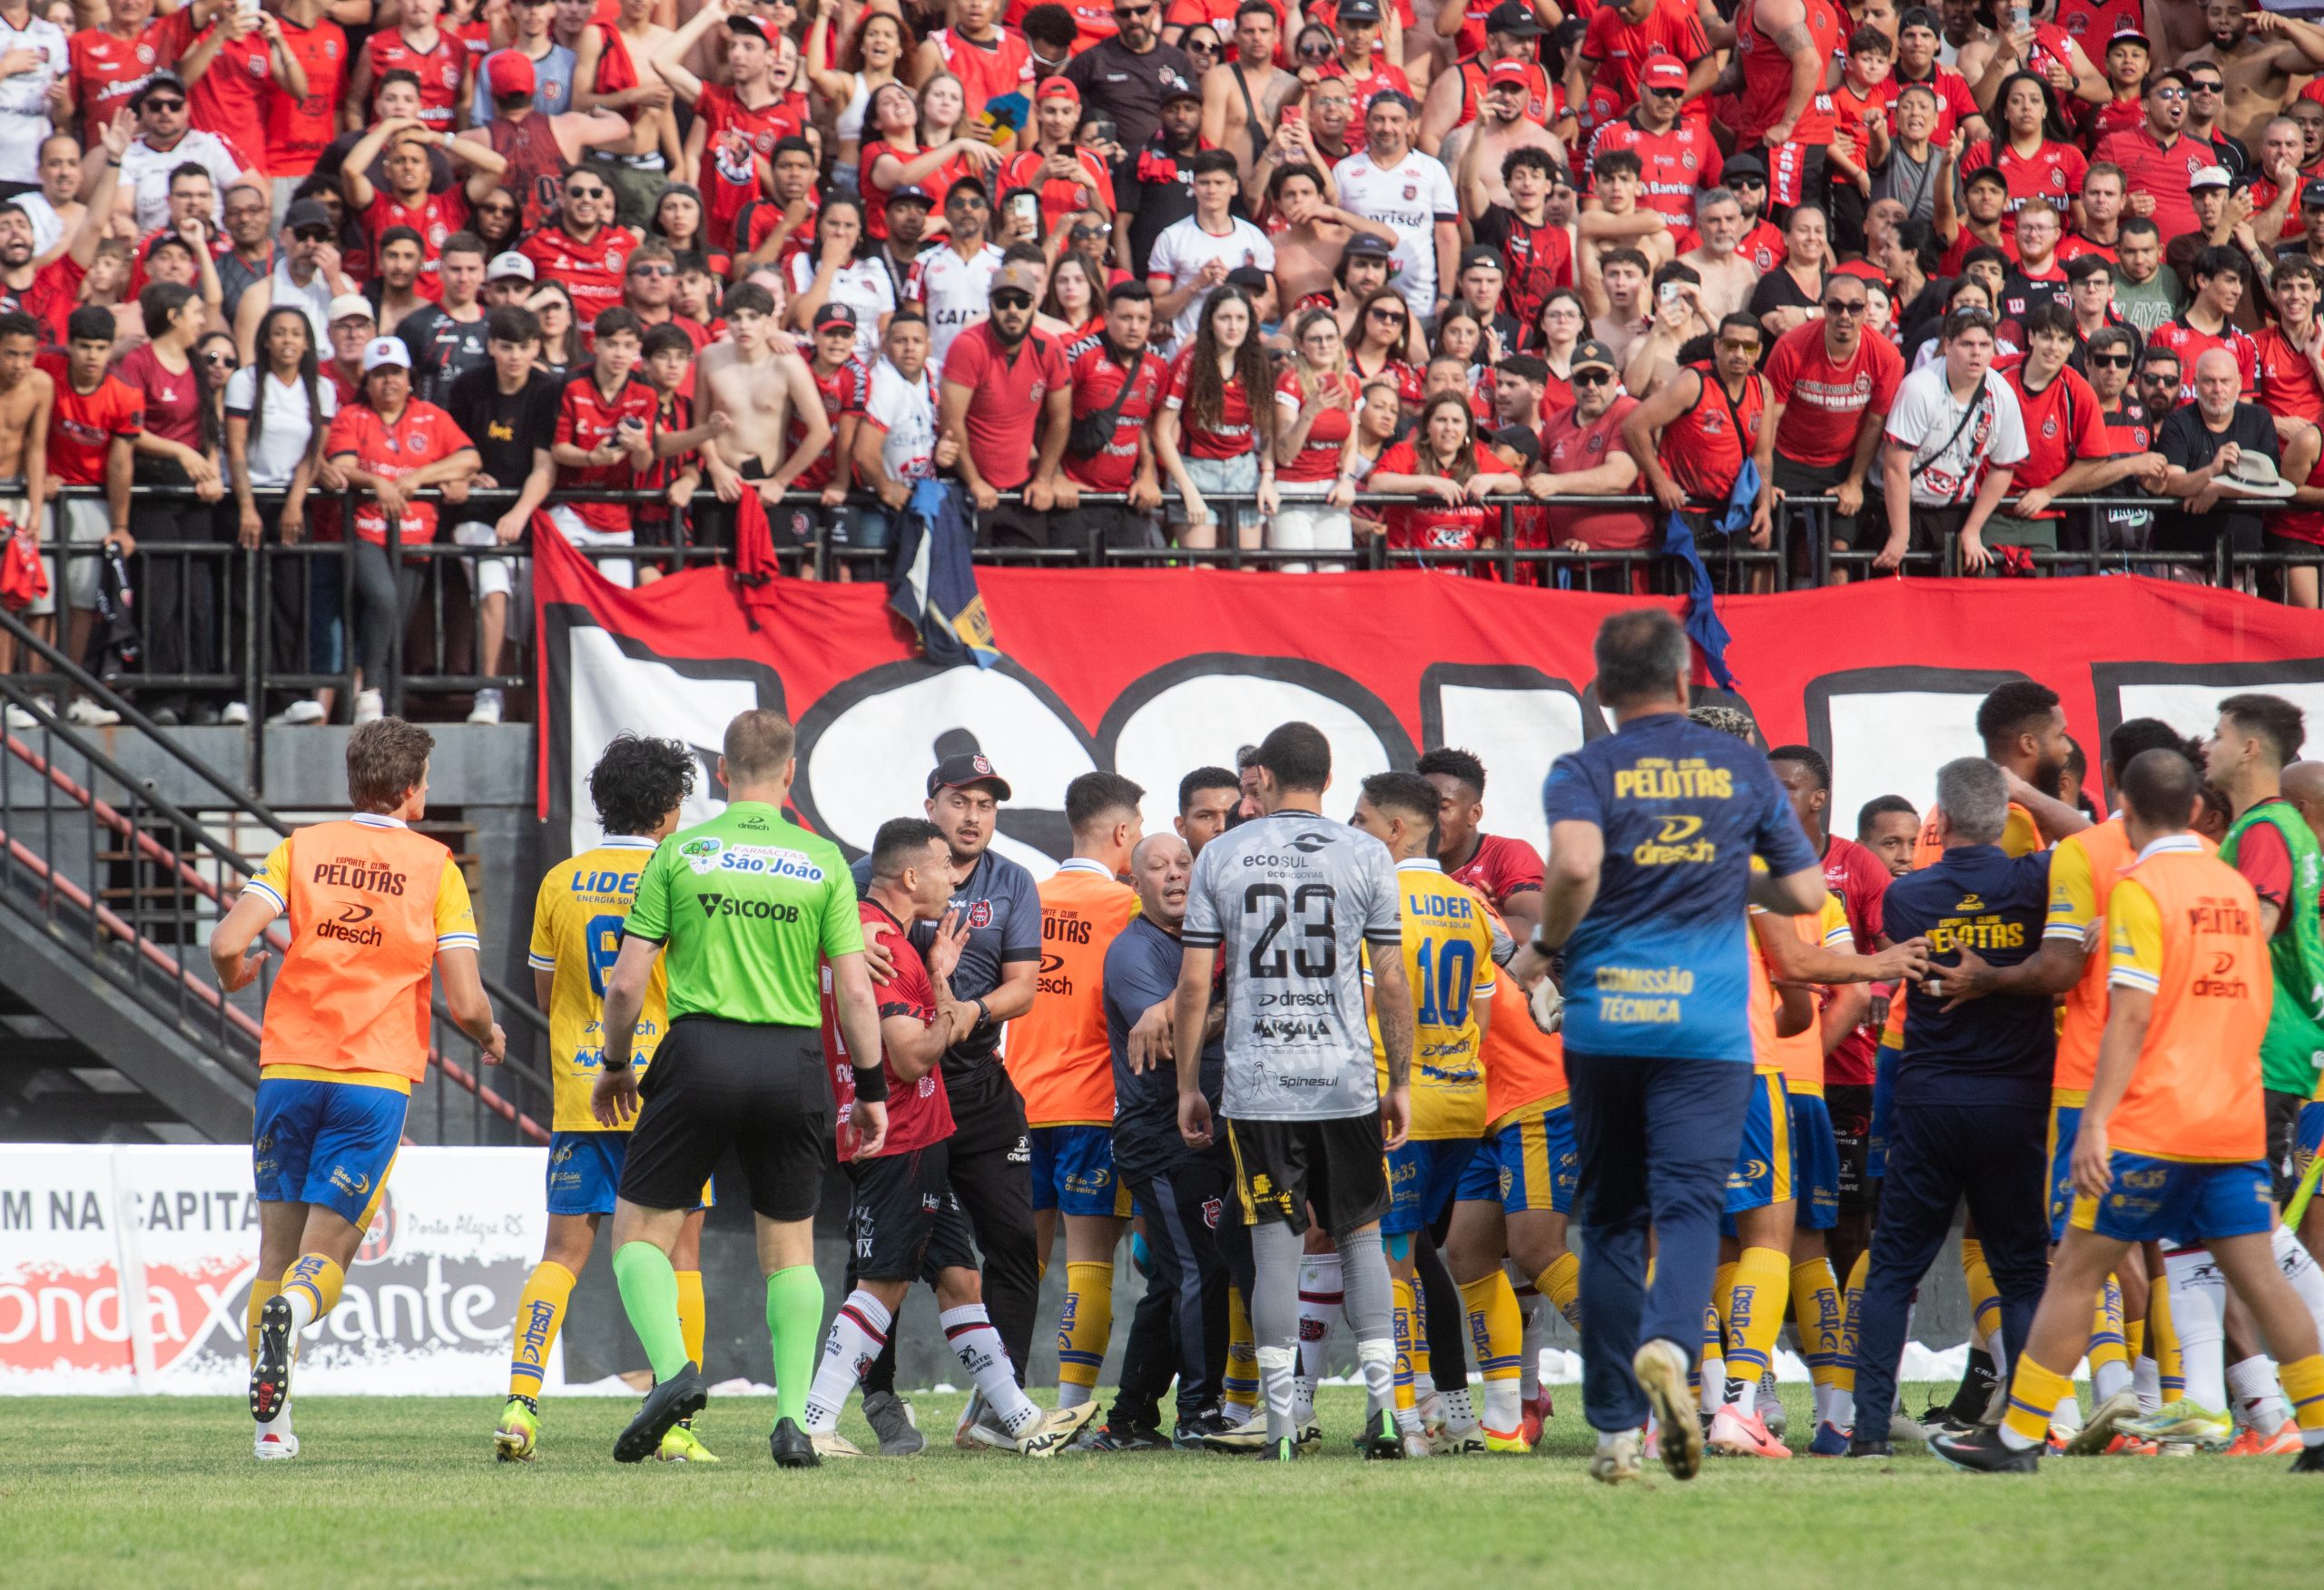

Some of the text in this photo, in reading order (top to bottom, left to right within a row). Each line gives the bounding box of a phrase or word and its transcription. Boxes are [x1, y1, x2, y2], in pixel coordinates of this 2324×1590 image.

[1615, 769, 1733, 800] PELOTAS
[738, 820, 770, 831] dresch
[335, 857, 391, 871] ESPORTE CLUBE
[733, 845, 806, 861] FARMÁCIAS
[1635, 839, 1715, 866] dresch
[313, 863, 407, 897] PELOTAS
[722, 852, 823, 882] São João
[571, 870, 639, 894] LÍDE
[576, 894, 633, 906] ENERGIA SOL
[722, 898, 800, 924] SICOOB
[1060, 910, 1079, 918] CLUBE
[1939, 915, 2002, 928] ESPORTE CLUBE
[317, 919, 382, 947] dresch
[1043, 918, 1092, 945] OTAS
[1244, 883, 1337, 979] 23
[1037, 976, 1073, 996] esch
[1418, 937, 1477, 1030] 10
[1596, 966, 1695, 996] COMISSÃO
[1280, 989, 1335, 1007] dresch
[1600, 996, 1680, 1023] TÉCNICA
[1279, 1075, 1339, 1089] Spinesul
[49, 1190, 104, 1231] NA
[1729, 1285, 1757, 1327] dresch
[521, 1300, 556, 1347] dresch
